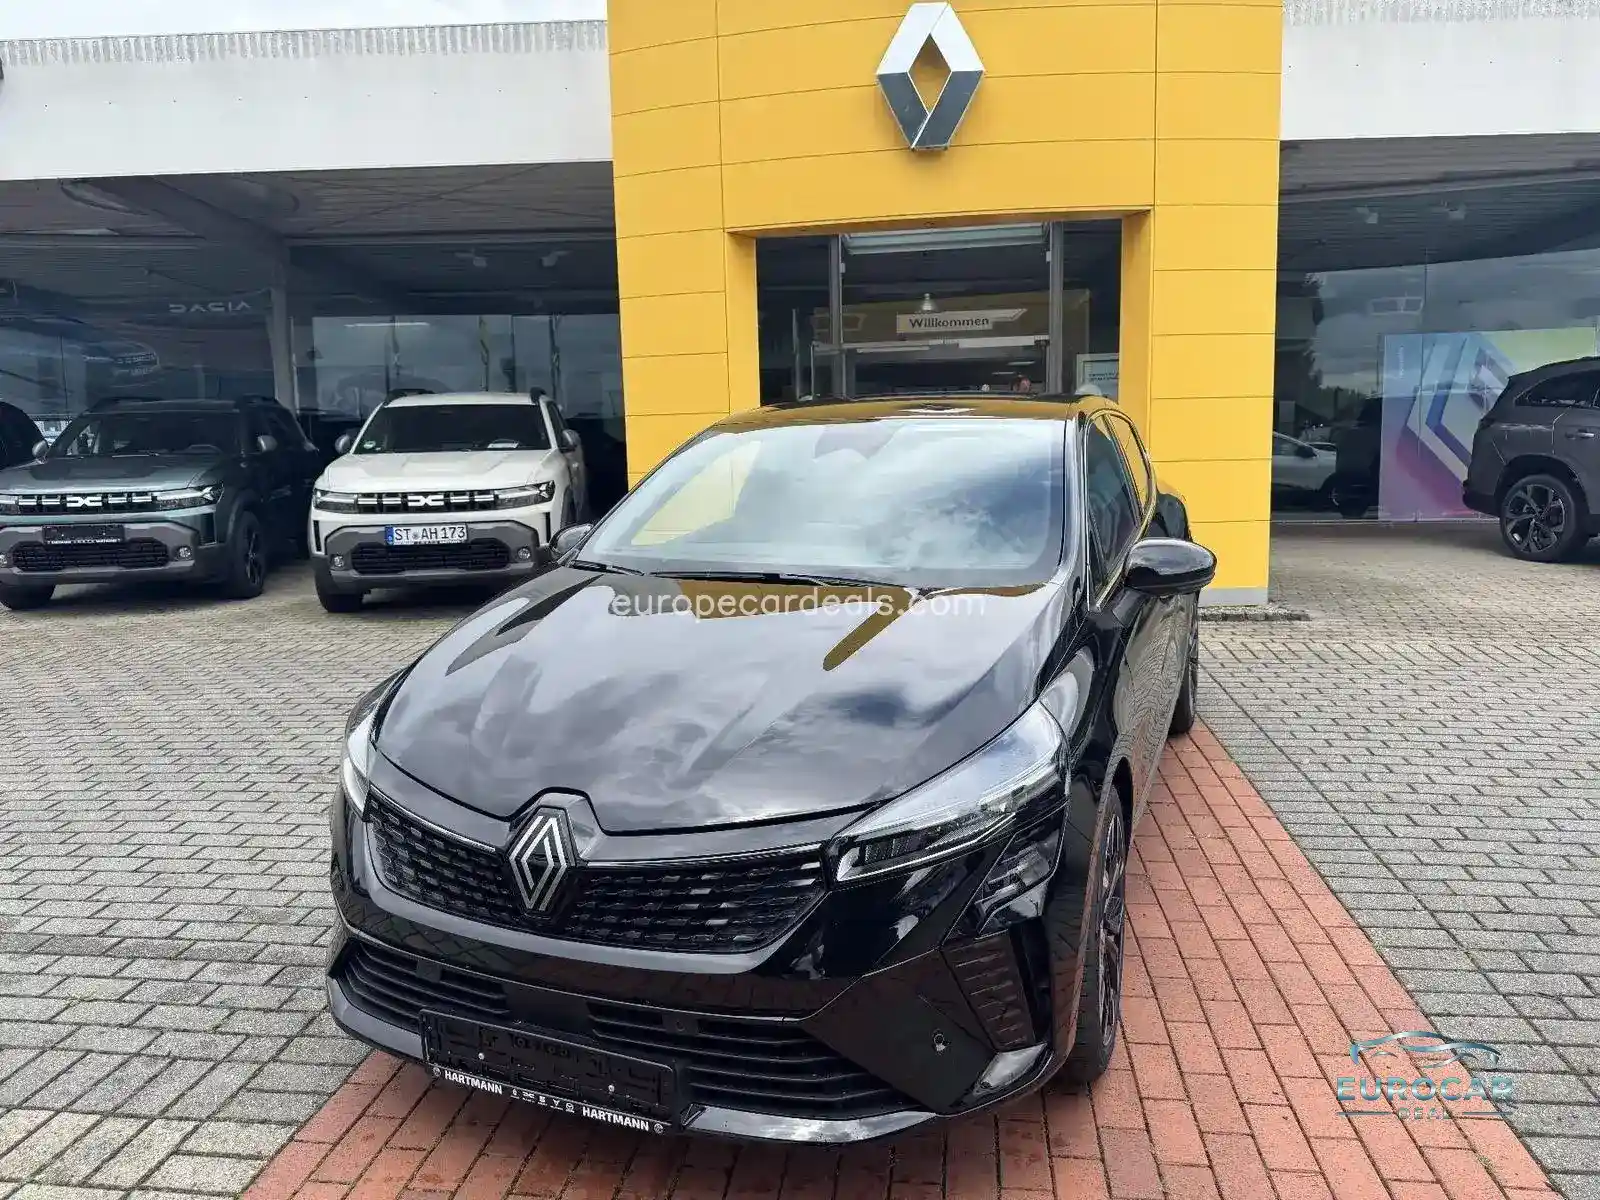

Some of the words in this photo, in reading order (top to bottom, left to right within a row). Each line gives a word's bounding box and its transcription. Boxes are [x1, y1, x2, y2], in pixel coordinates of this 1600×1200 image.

[169, 301, 251, 313] DACIA
[909, 317, 989, 328] Willkommen
[395, 528, 411, 541] ST
[421, 527, 438, 540] AH
[441, 526, 465, 539] 173
[444, 1070, 503, 1095] HARTMANN
[583, 1106, 649, 1132] HARTMANN
